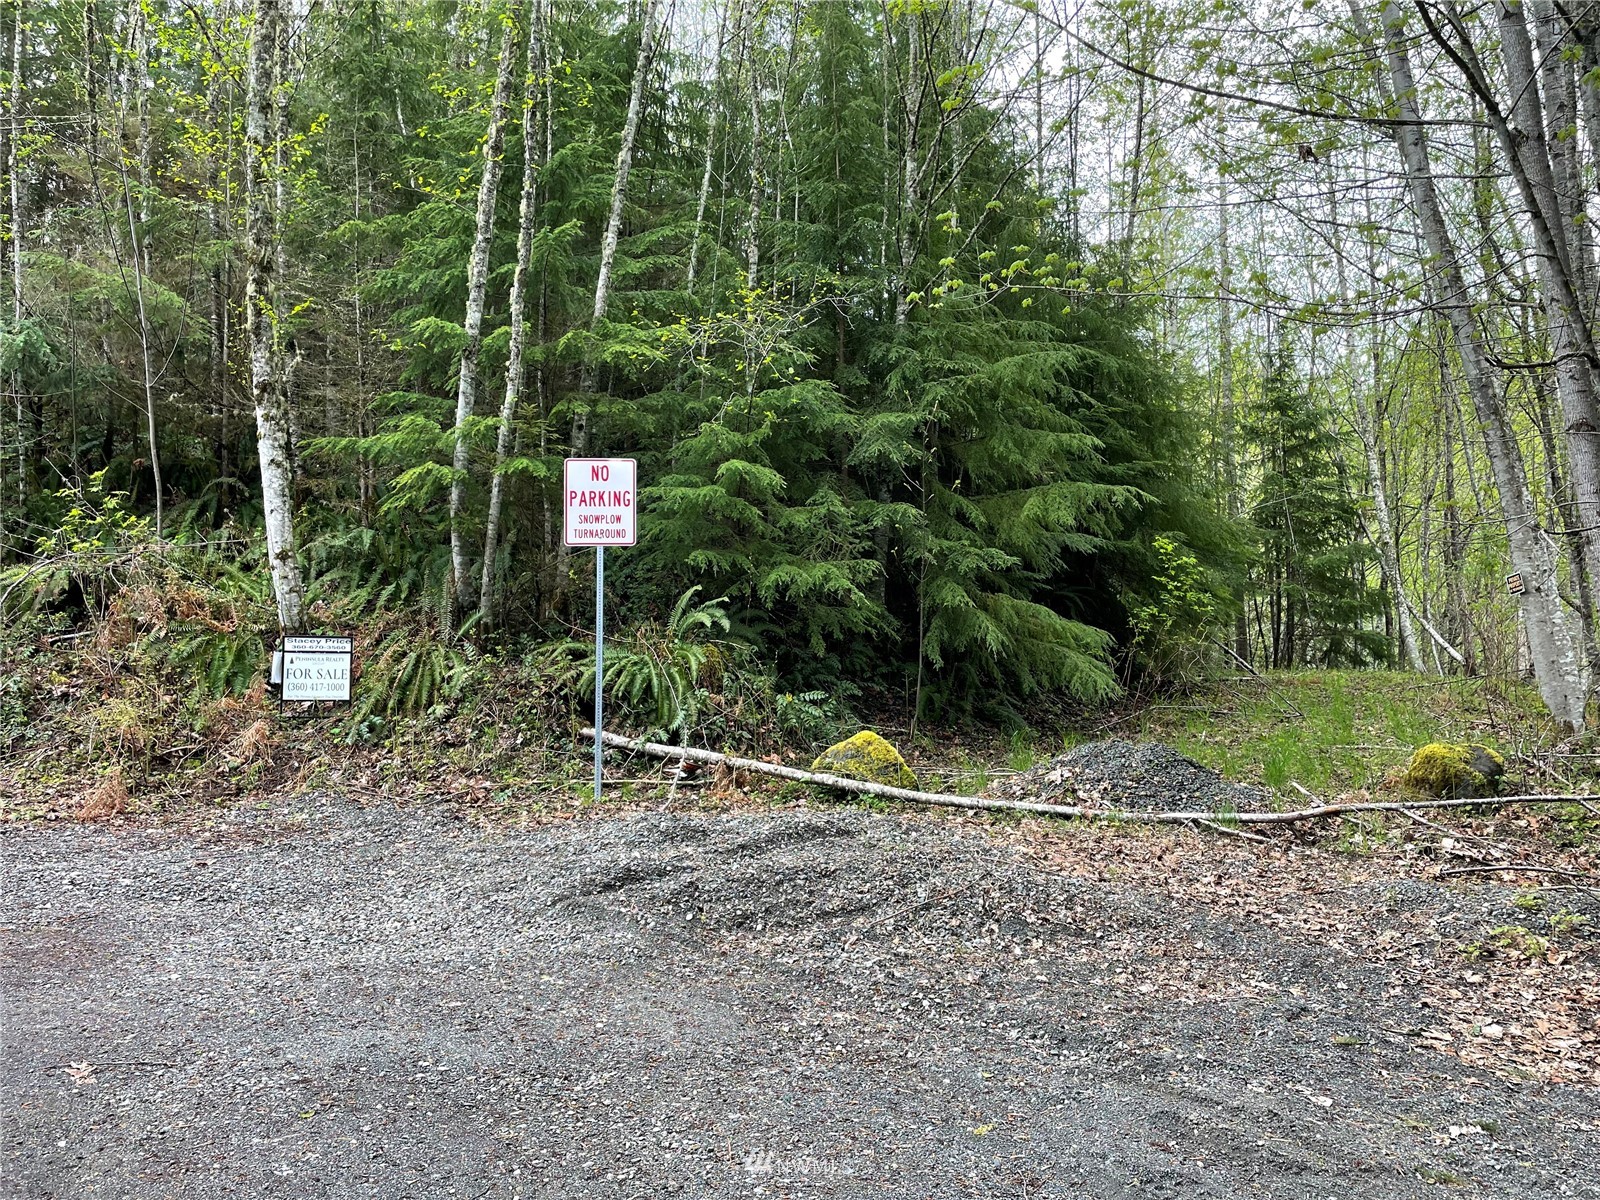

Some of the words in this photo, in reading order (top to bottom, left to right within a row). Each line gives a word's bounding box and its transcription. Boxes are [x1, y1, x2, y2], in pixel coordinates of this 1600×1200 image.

[591, 465, 609, 482] NO
[569, 490, 631, 507] PARKING
[578, 514, 622, 524] SNOWPLOW
[573, 528, 627, 539] TURNAROUND
[286, 668, 312, 680] FOR
[316, 668, 348, 680] SALE
[287, 682, 308, 692] (360)
[309, 682, 345, 692] 417-1000
